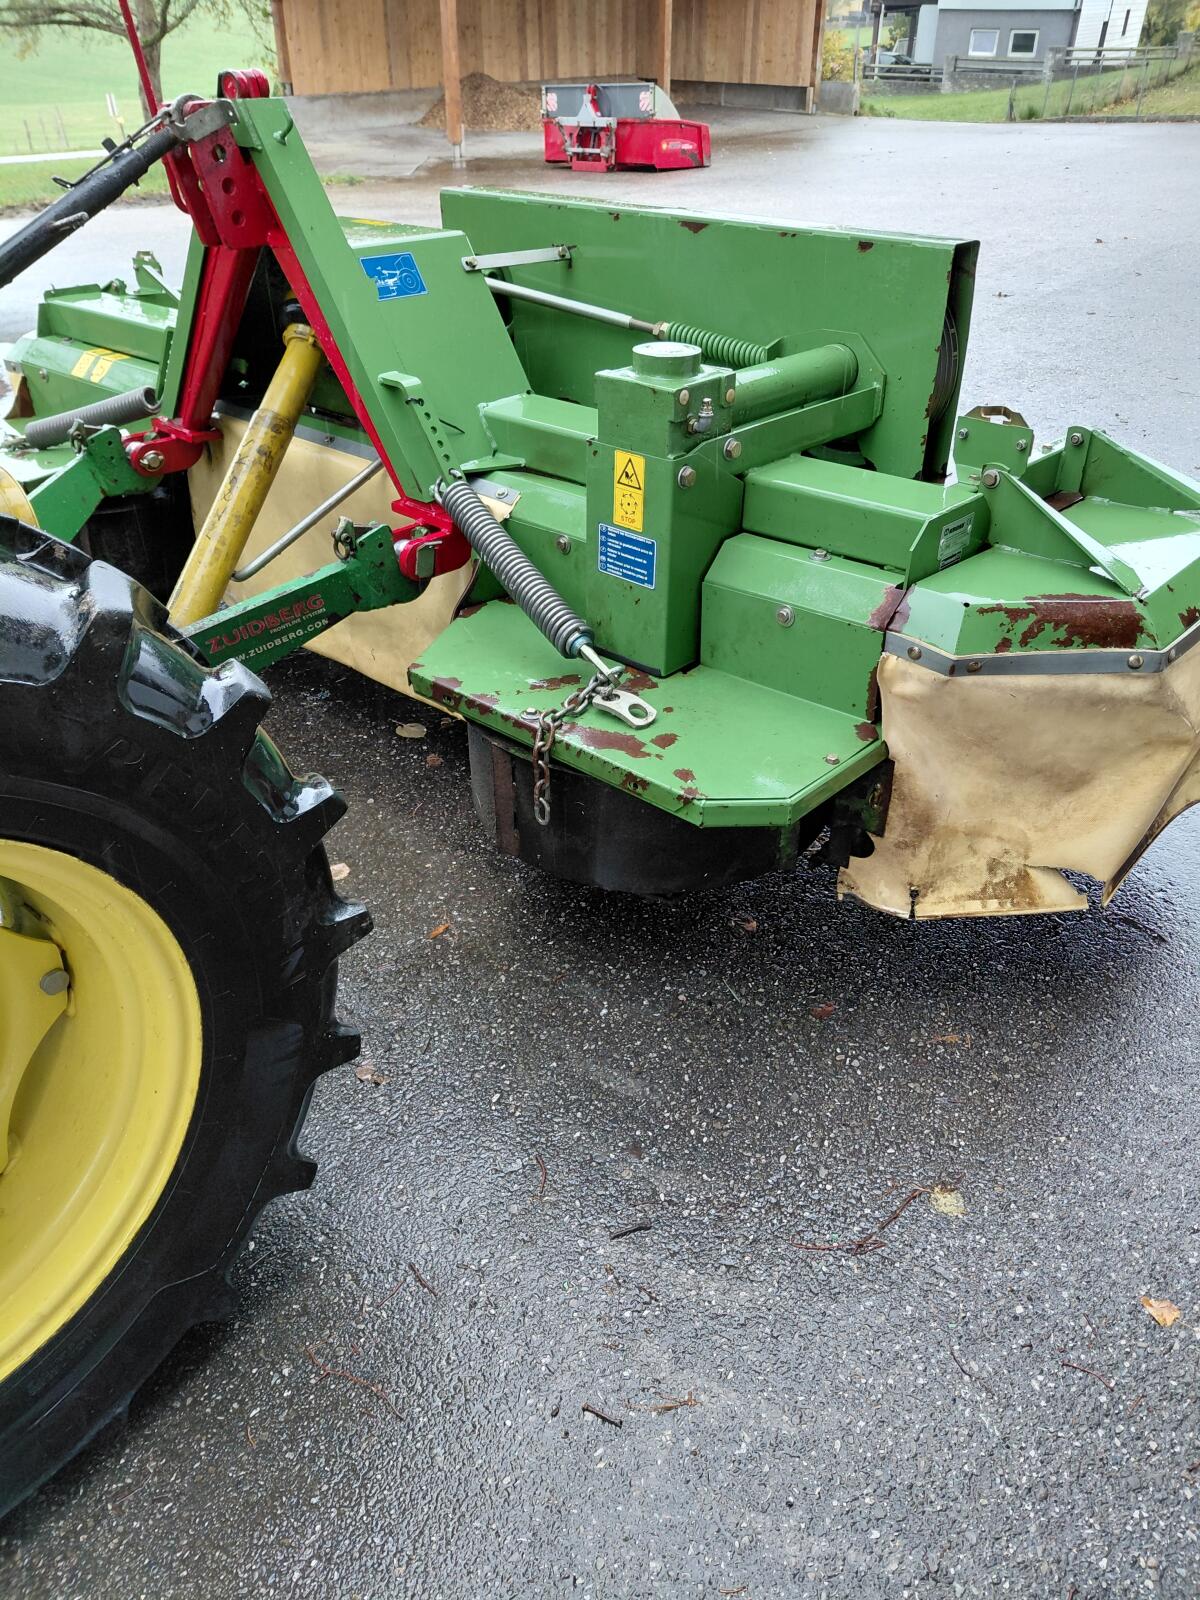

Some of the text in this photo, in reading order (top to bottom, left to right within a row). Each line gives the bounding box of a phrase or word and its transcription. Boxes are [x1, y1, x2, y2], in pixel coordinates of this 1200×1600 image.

[621, 515, 636, 524] STOP
[205, 593, 325, 654] ZUIDBERG
[269, 607, 327, 634] FRONTLINE SYSTEMS
